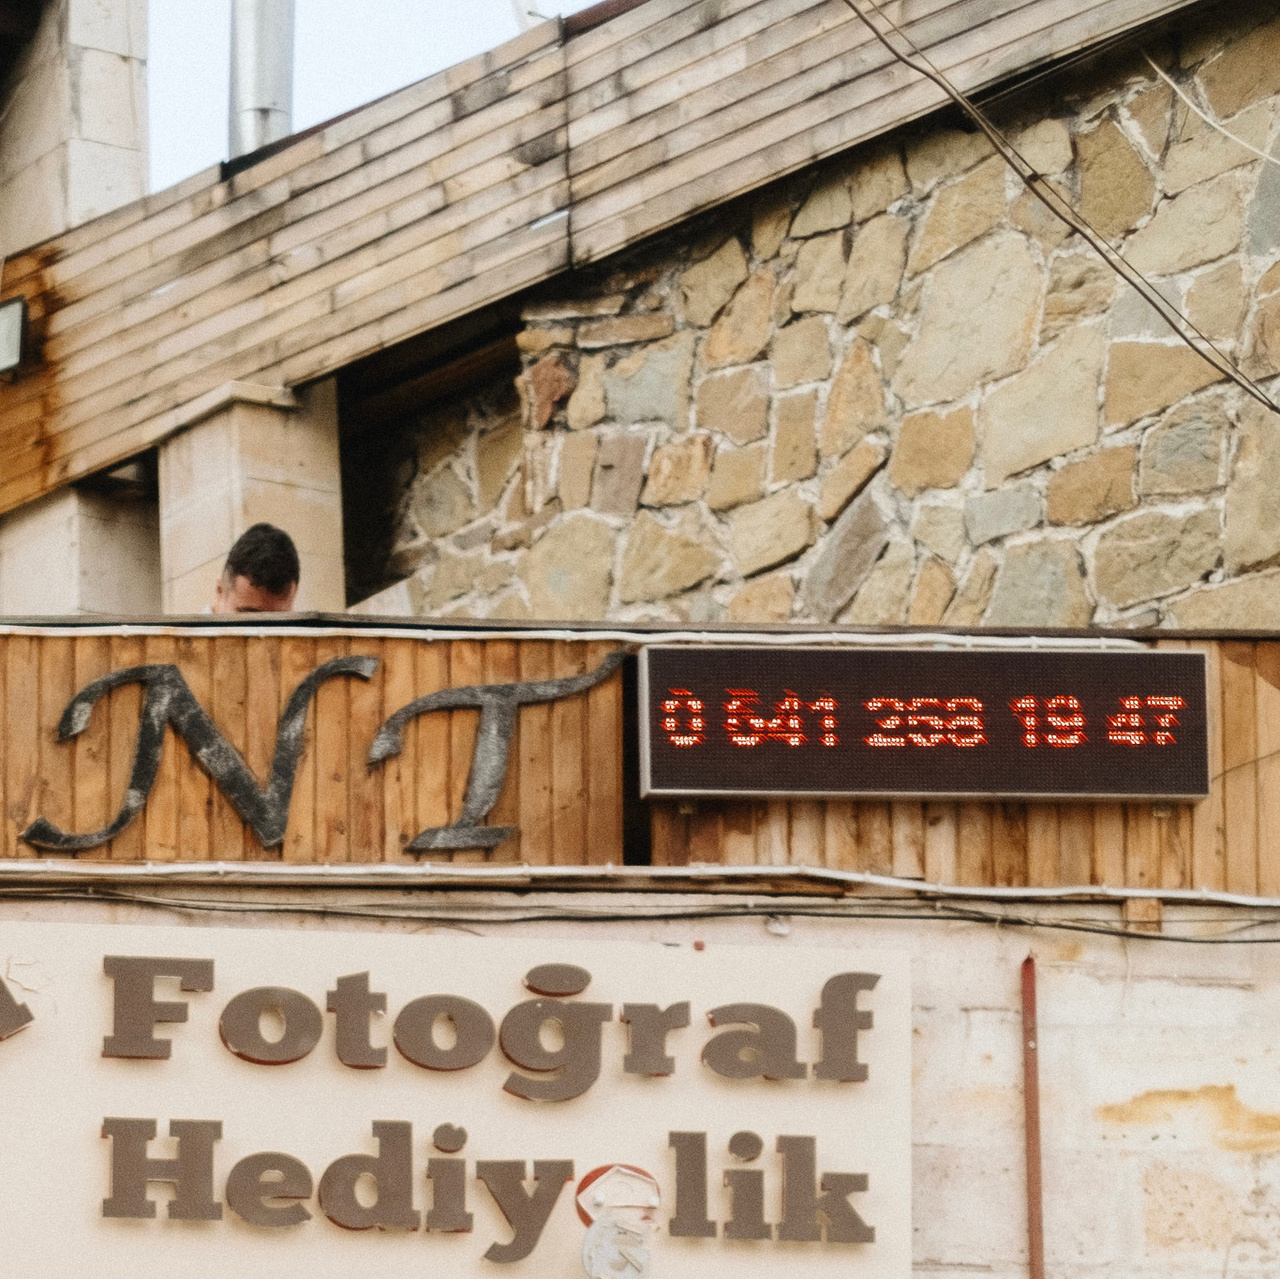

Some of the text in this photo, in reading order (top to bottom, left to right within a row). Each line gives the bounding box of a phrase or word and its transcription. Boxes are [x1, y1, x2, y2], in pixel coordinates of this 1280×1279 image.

[661, 688, 705, 748] 0
[1008, 695, 1088, 747] 19
[1106, 695, 1188, 746] 47
[101, 954, 882, 1102] Fotoğraf
[101, 1117, 876, 1263] Hediylik
